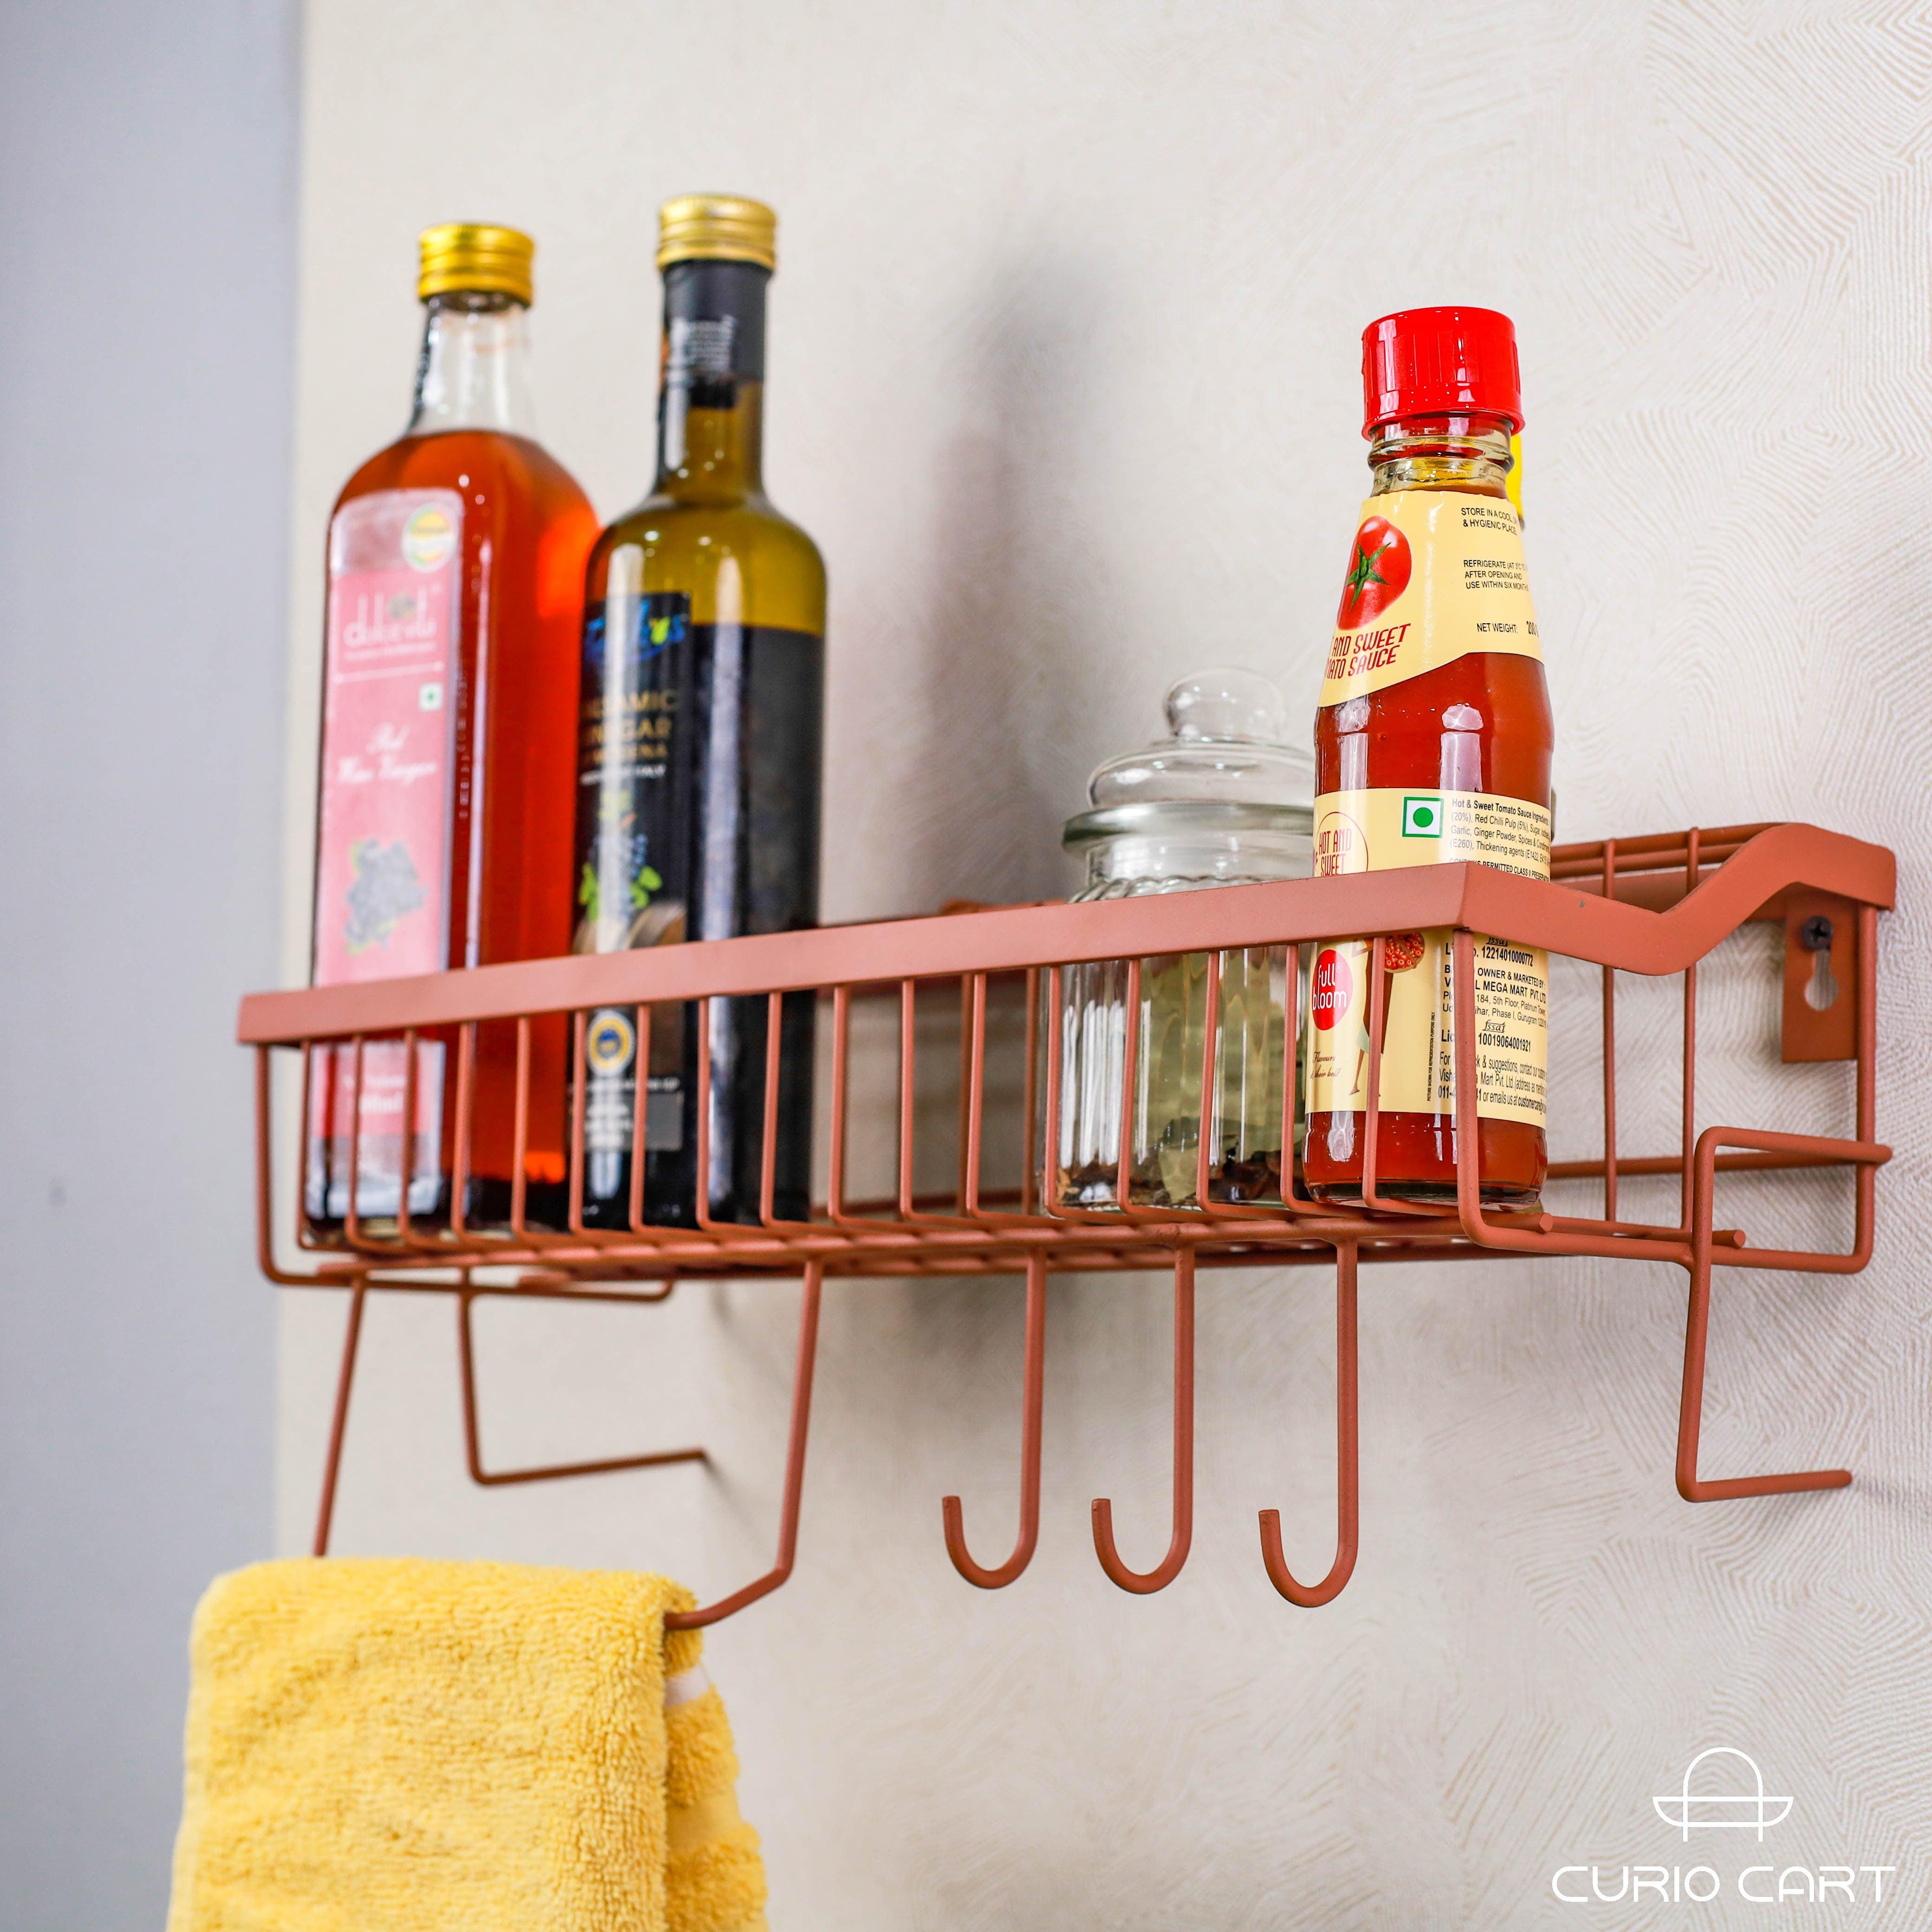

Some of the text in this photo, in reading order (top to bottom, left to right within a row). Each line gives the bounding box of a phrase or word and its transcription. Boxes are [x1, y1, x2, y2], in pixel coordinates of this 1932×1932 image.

[1461, 508, 1485, 516] STORE
[1487, 509, 1493, 517] IN
[1499, 511, 1513, 522] COOL
[1470, 519, 1501, 530] HYGIENIC
[1463, 560, 1506, 568] REFRIGERATE
[1488, 571, 1513, 579] OPENING
[1477, 623, 1491, 632] NET
[1492, 623, 1518, 633] WEIGHT:
[1332, 623, 1411, 657] AND SWEET
[1348, 644, 1401, 677] SAUCE
[1452, 798, 1464, 808] Hot
[1467, 799, 1471, 809] &
[1474, 800, 1494, 811] Sweet
[1495, 803, 1516, 816] Tomato
[1517, 807, 1532, 819] Sauce
[1451, 812, 1473, 824] (20%),
[1475, 814, 1488, 824] Red
[1489, 816, 1504, 826] Chilli
[1505, 818, 1517, 829] Pulp
[1319, 828, 1352, 855] HOT AND
[1451, 825, 1472, 836] Garlic,
[1474, 827, 1495, 839] Ginger
[1496, 830, 1517, 843] Powder,
[1518, 834, 1533, 846] Spices
[1533, 838, 1536, 846] &
[1450, 838, 1474, 851] (E260),
[1476, 841, 1508, 855] Thickening
[1509, 848, 1524, 857] agents
[1321, 853, 1346, 877] SWEET
[1514, 866, 1528, 876] CLASS
[1482, 946, 1533, 966] 12214010000772
[1318, 963, 1336, 987] full
[1477, 967, 1506, 979] OWNER
[1508, 972, 1512, 980] &
[1514, 973, 1539, 987] MARKETED
[1312, 986, 1347, 1011] bloom
[1483, 980, 1508, 993] MEGA
[1510, 984, 1527, 998] MART
[1530, 989, 1539, 1001] PVT.
[1476, 994, 1491, 1005] 184,
[1493, 996, 1503, 1005] 5th
[1505, 998, 1520, 1009] Floor,
[1475, 1006, 1490, 1017] ihar,
[1492, 1008, 1511, 1018] Phase
[1478, 1032, 1531, 1052] 10019064001921
[1440, 1051, 1450, 1065] For
[1482, 1055, 1486, 1068] &
[1489, 1058, 1519, 1074] suggestions,
[1520, 1062, 1533, 1076] contact
[1439, 1068, 1456, 1082] Visha
[1481, 1071, 1493, 1086] Mart
[1495, 1073, 1505, 1088] Pvt.
[1506, 1075, 1514, 1089] Ltd.
[1514, 1076, 1531, 1092] (address
[1483, 1091, 1488, 1102] or
[1490, 1091, 1506, 1106] emails
[1507, 1095, 1513, 1105] us
[1513, 1094, 1518, 1106] at
